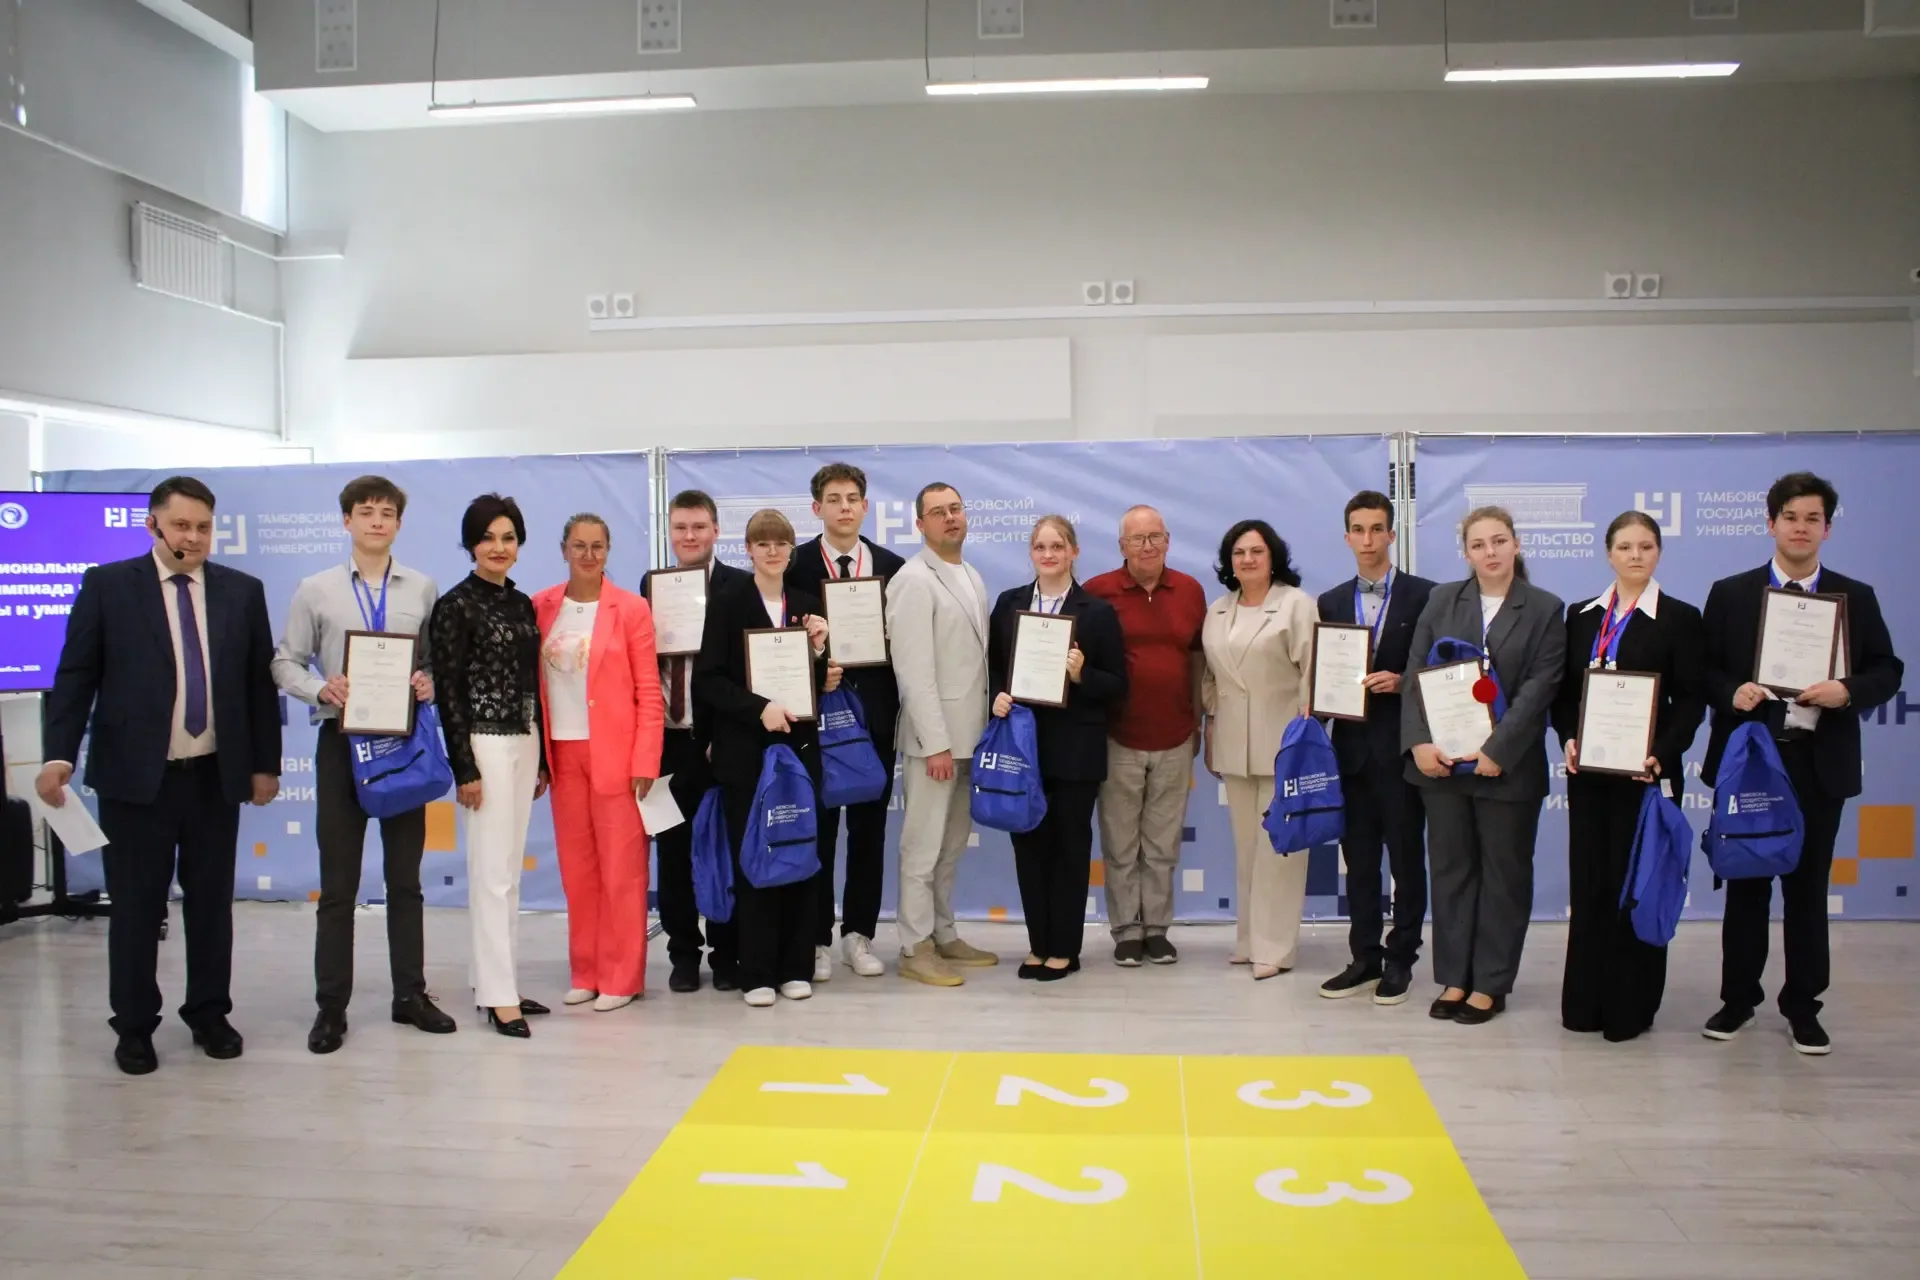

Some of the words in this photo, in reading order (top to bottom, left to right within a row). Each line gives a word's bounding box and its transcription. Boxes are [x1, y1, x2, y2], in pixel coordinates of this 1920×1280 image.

[963, 496, 1034, 511] БОВСКИЙ
[1697, 491, 1769, 504] ТАМБОВС
[966, 512, 1080, 528] УДАРСТВЕЙ
[1697, 507, 1844, 519] ГОСУДАРСЙ
[965, 531, 1032, 543] ВЕРСИТЕ
[1696, 524, 1769, 536] УНИВЕРСИ
[259, 543, 344, 555] УНИВЕРСИТЕТ
[1539, 548, 1594, 559] ОБЛАСТИ
[0, 562, 99, 574] иональна
[15, 605, 29, 617] и
[32, 604, 74, 620] умн
[759, 1073, 889, 1095] 1
[995, 1075, 1130, 1107] 2
[1236, 1080, 1374, 1110] 3
[698, 1161, 848, 1189] 1
[971, 1162, 1129, 1204] 2
[1254, 1168, 1414, 1207] 3
